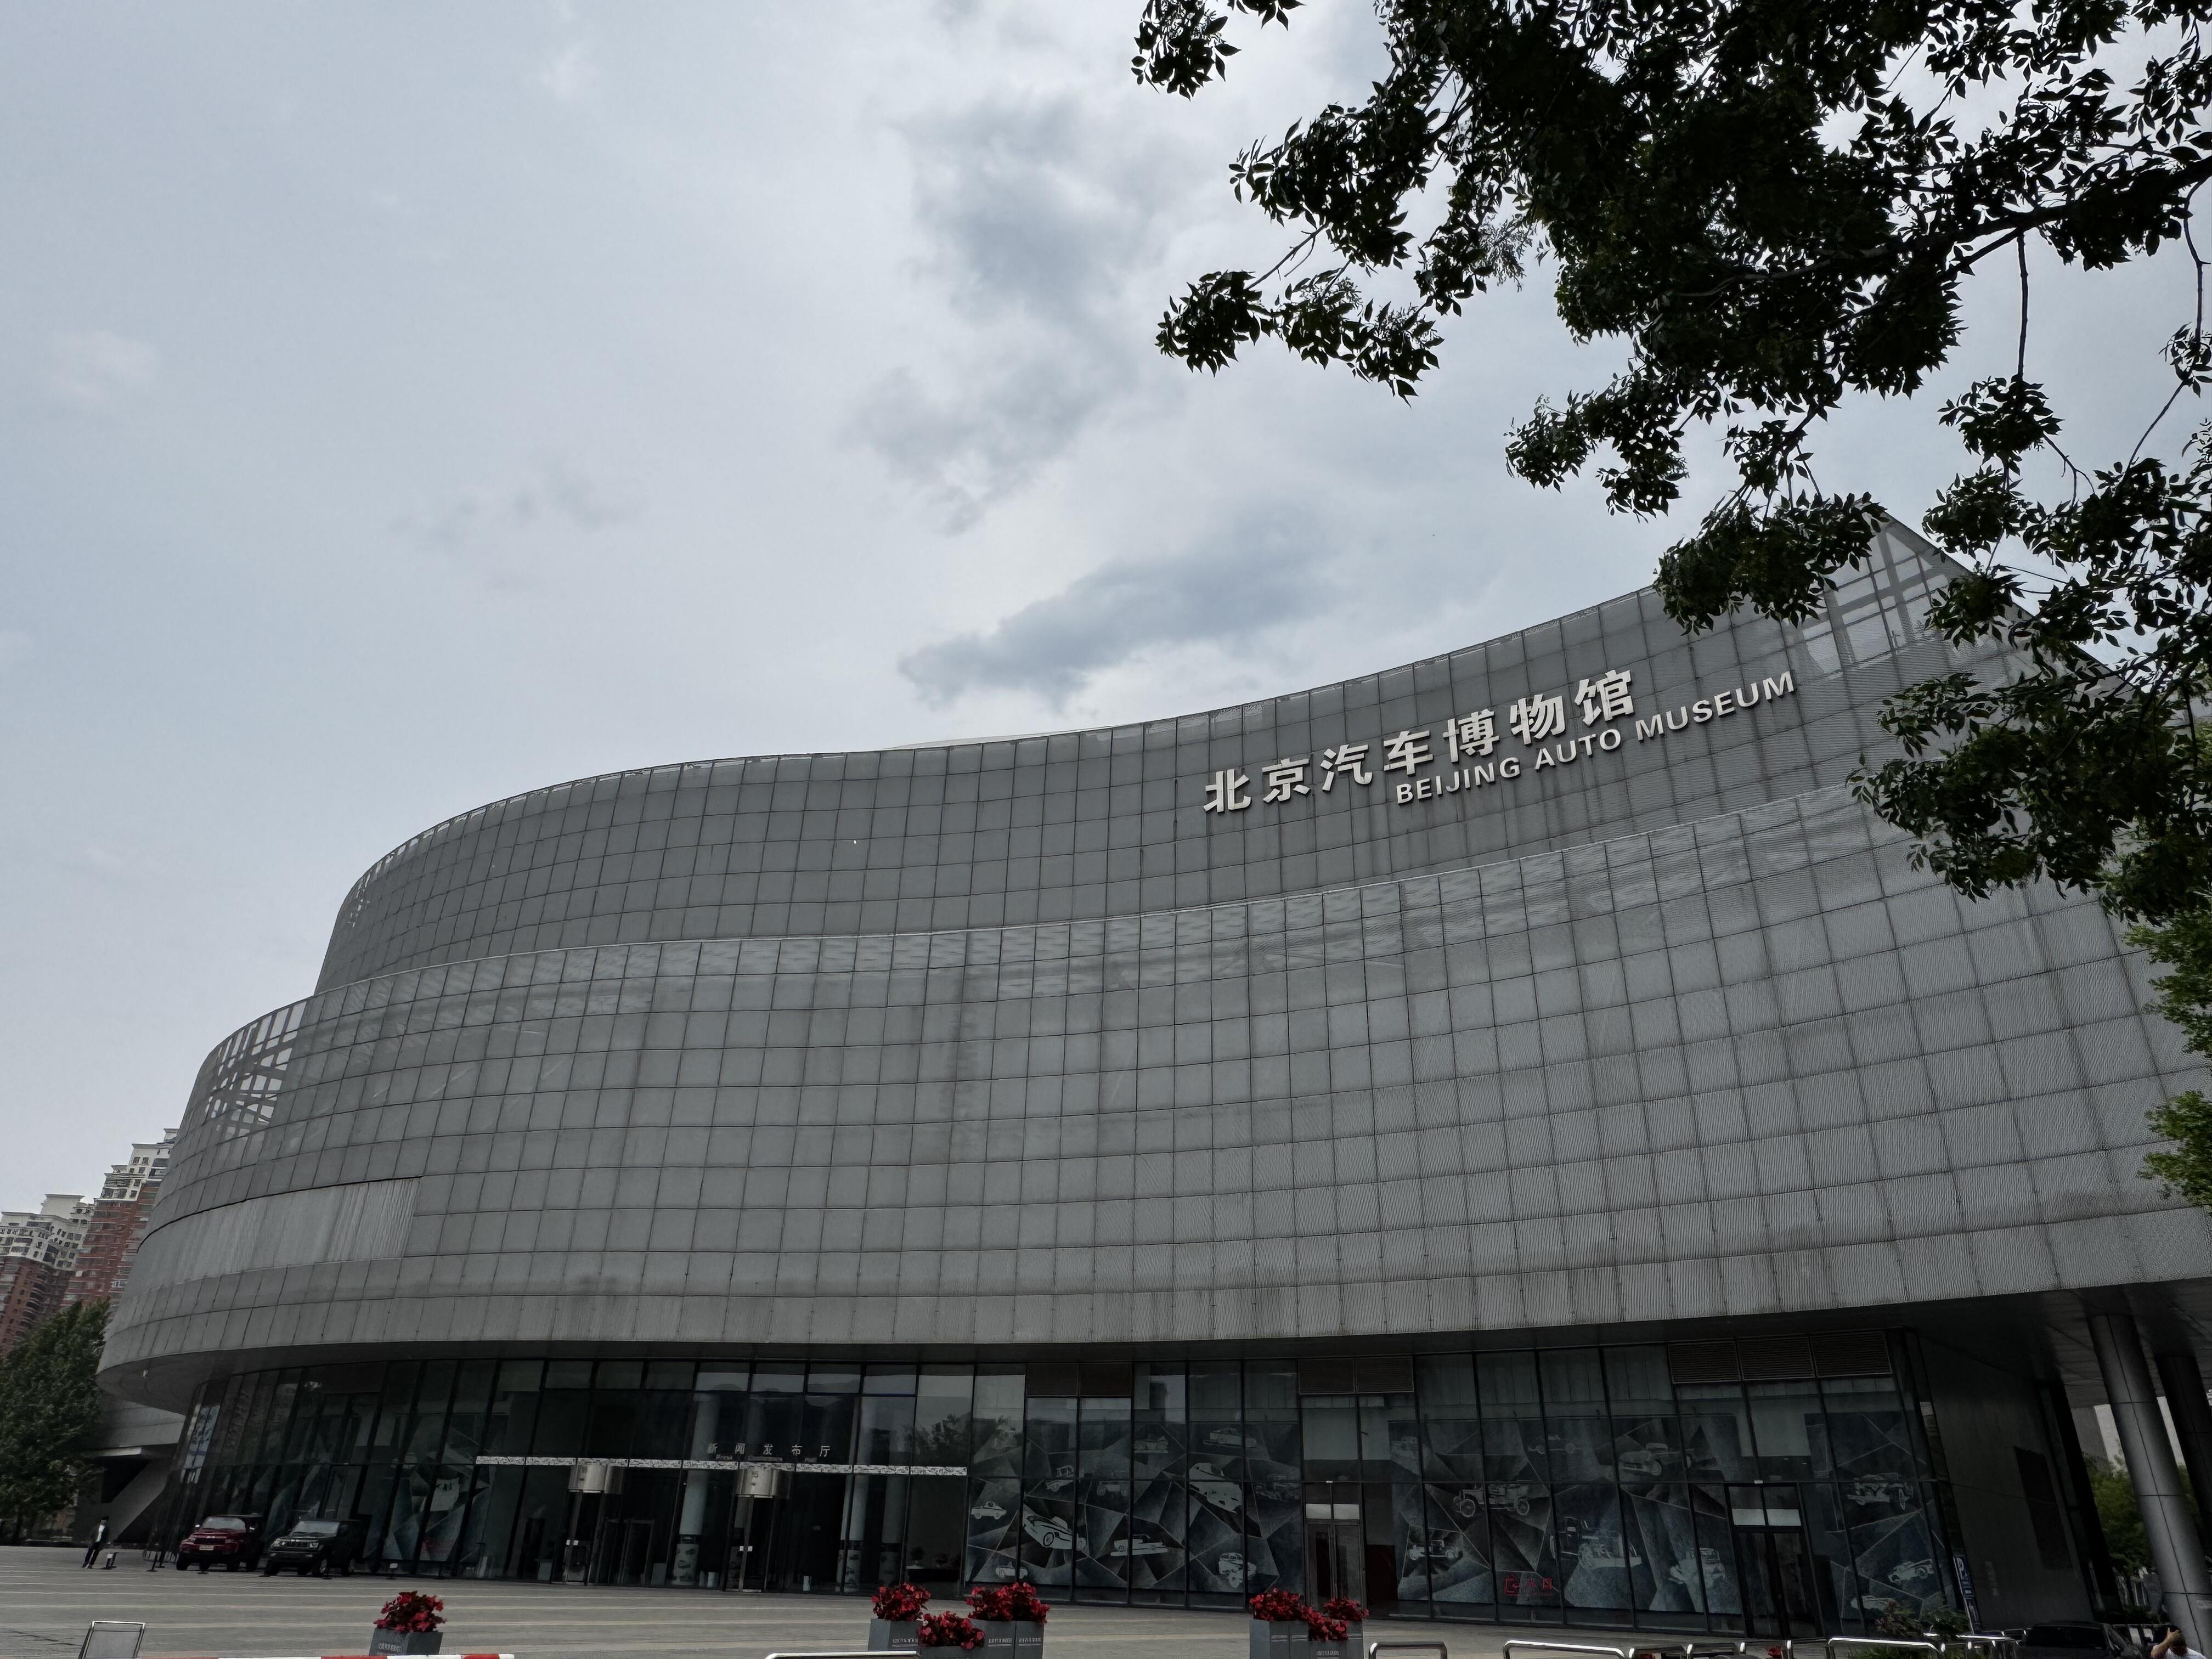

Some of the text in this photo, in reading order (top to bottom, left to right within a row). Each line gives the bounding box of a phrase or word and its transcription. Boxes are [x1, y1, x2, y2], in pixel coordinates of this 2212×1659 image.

[1203, 669, 1635, 814] 北京汽车博物馆
[1396, 670, 1795, 805] BEIJING AUTO MUSEUM
[707, 1442, 831, 1457] 新闻发布厅
